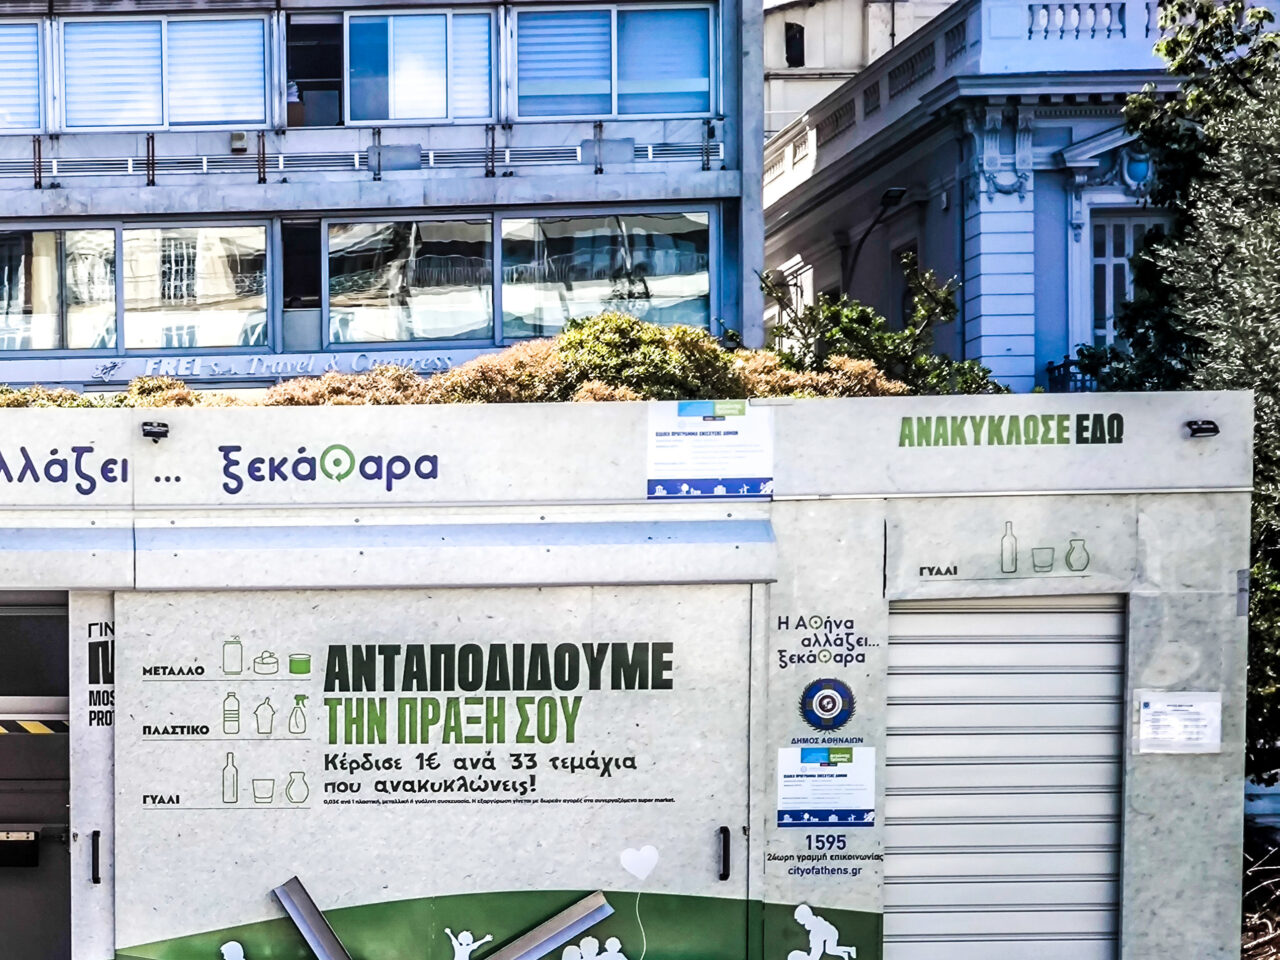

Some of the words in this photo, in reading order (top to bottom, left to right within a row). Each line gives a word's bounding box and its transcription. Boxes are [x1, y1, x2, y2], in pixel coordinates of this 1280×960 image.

[145, 358, 202, 376] FREI
[247, 355, 315, 375] Travel
[323, 355, 340, 373] &
[898, 414, 1070, 447] ΑΝΑΚΥΚΛΩΣΕ
[1075, 413, 1124, 445] ΕΔΩ
[919, 566, 958, 576] ΓΥΑΛΙ
[777, 616, 789, 630] Η
[142, 666, 205, 676] ΜΕΤΑΛΛΟ
[323, 642, 674, 692] ΑΝΤΑΠΟΔΙΔΟΥΜΕ
[323, 697, 387, 745] ΤΗΝ
[397, 696, 506, 745] ΠΡΑΞΗ
[515, 695, 583, 744] ΣΟΥ
[142, 725, 210, 735] ΠΛΑΣΤΙΚΟ
[790, 737, 820, 745] ΔΗΜΟΣ
[821, 737, 864, 745] ΑΘΗΝΑΙΩΝ
[323, 751, 403, 774] Κέρδισε
[415, 752, 441, 771] 1€
[453, 750, 497, 771] ανά
[509, 752, 538, 770] 33
[549, 750, 638, 777] τεμάχια
[323, 780, 362, 794] που
[374, 774, 538, 796] ανακυκλώνεις!
[142, 794, 180, 804] ΓΥΑΛΙ
[805, 834, 847, 850] 1595
[796, 853, 828, 863] γραμμή
[829, 852, 884, 862] επικοινωνίας
[787, 866, 863, 877] cityofathens.gr
